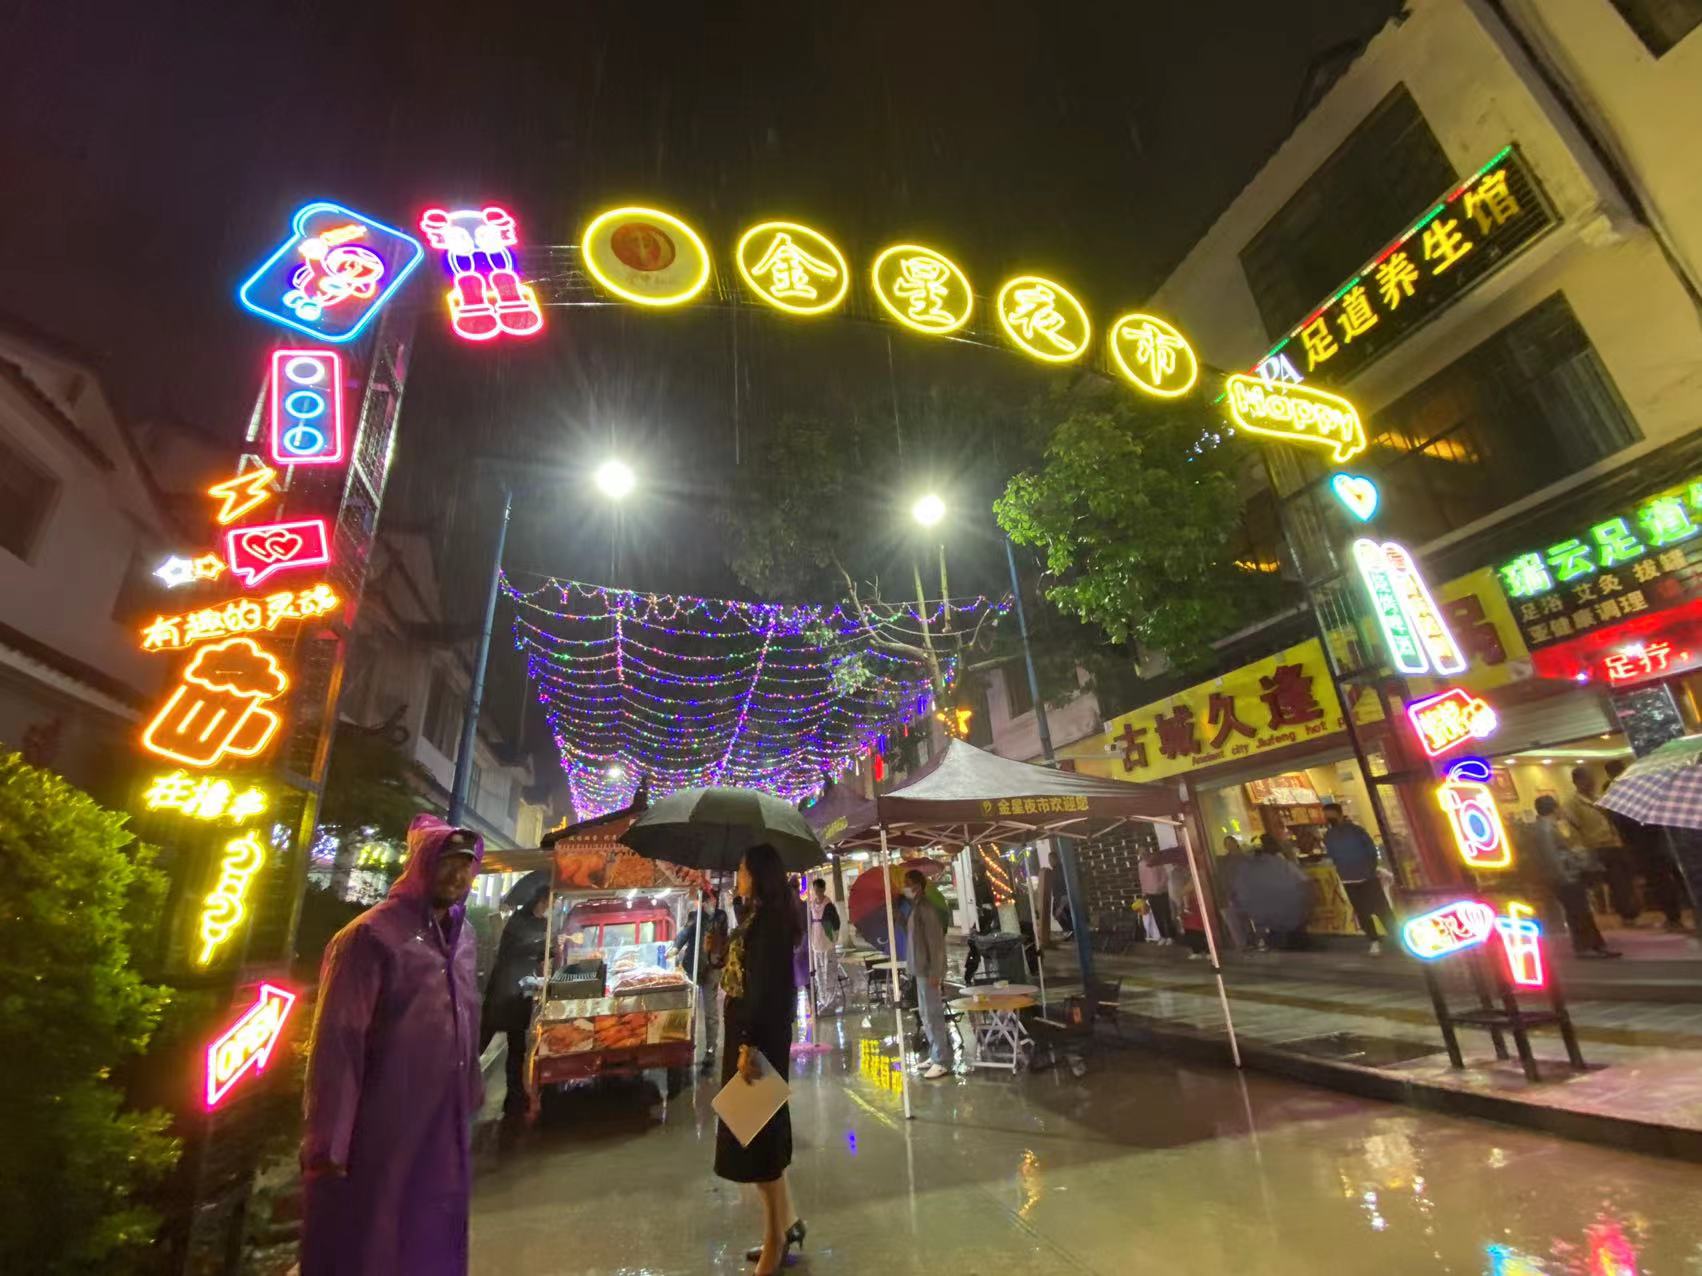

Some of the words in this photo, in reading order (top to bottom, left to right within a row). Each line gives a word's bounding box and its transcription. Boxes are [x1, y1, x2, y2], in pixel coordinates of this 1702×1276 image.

[1300, 170, 1519, 372] 足道养生馆
